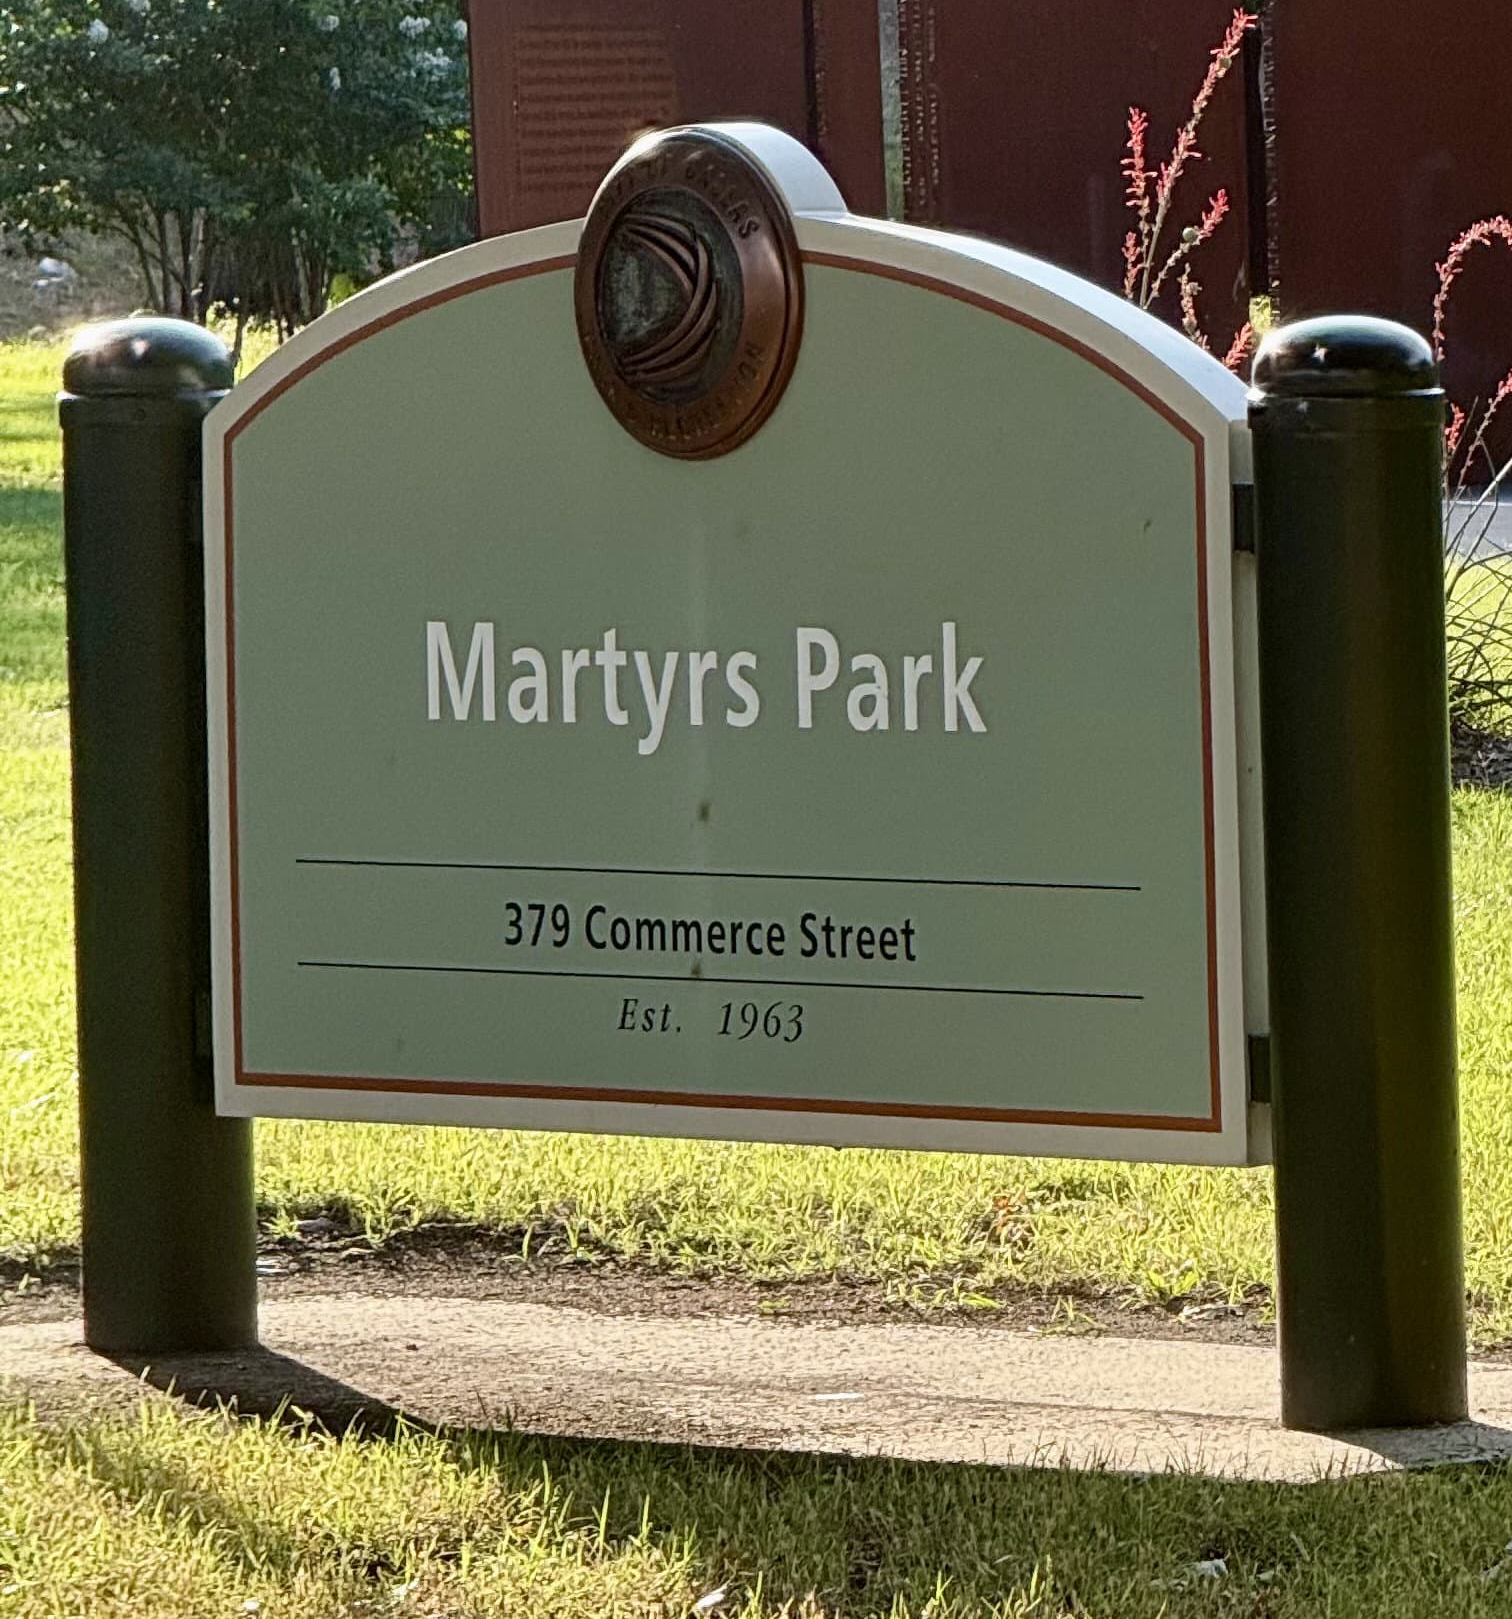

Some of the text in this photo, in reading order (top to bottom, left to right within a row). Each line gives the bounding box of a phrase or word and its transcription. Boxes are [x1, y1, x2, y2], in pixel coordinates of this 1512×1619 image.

[427, 621, 987, 755] Martyrs Park
[505, 902, 916, 961] 379 Commerce Street
[618, 999, 803, 1042] Est. 1963
